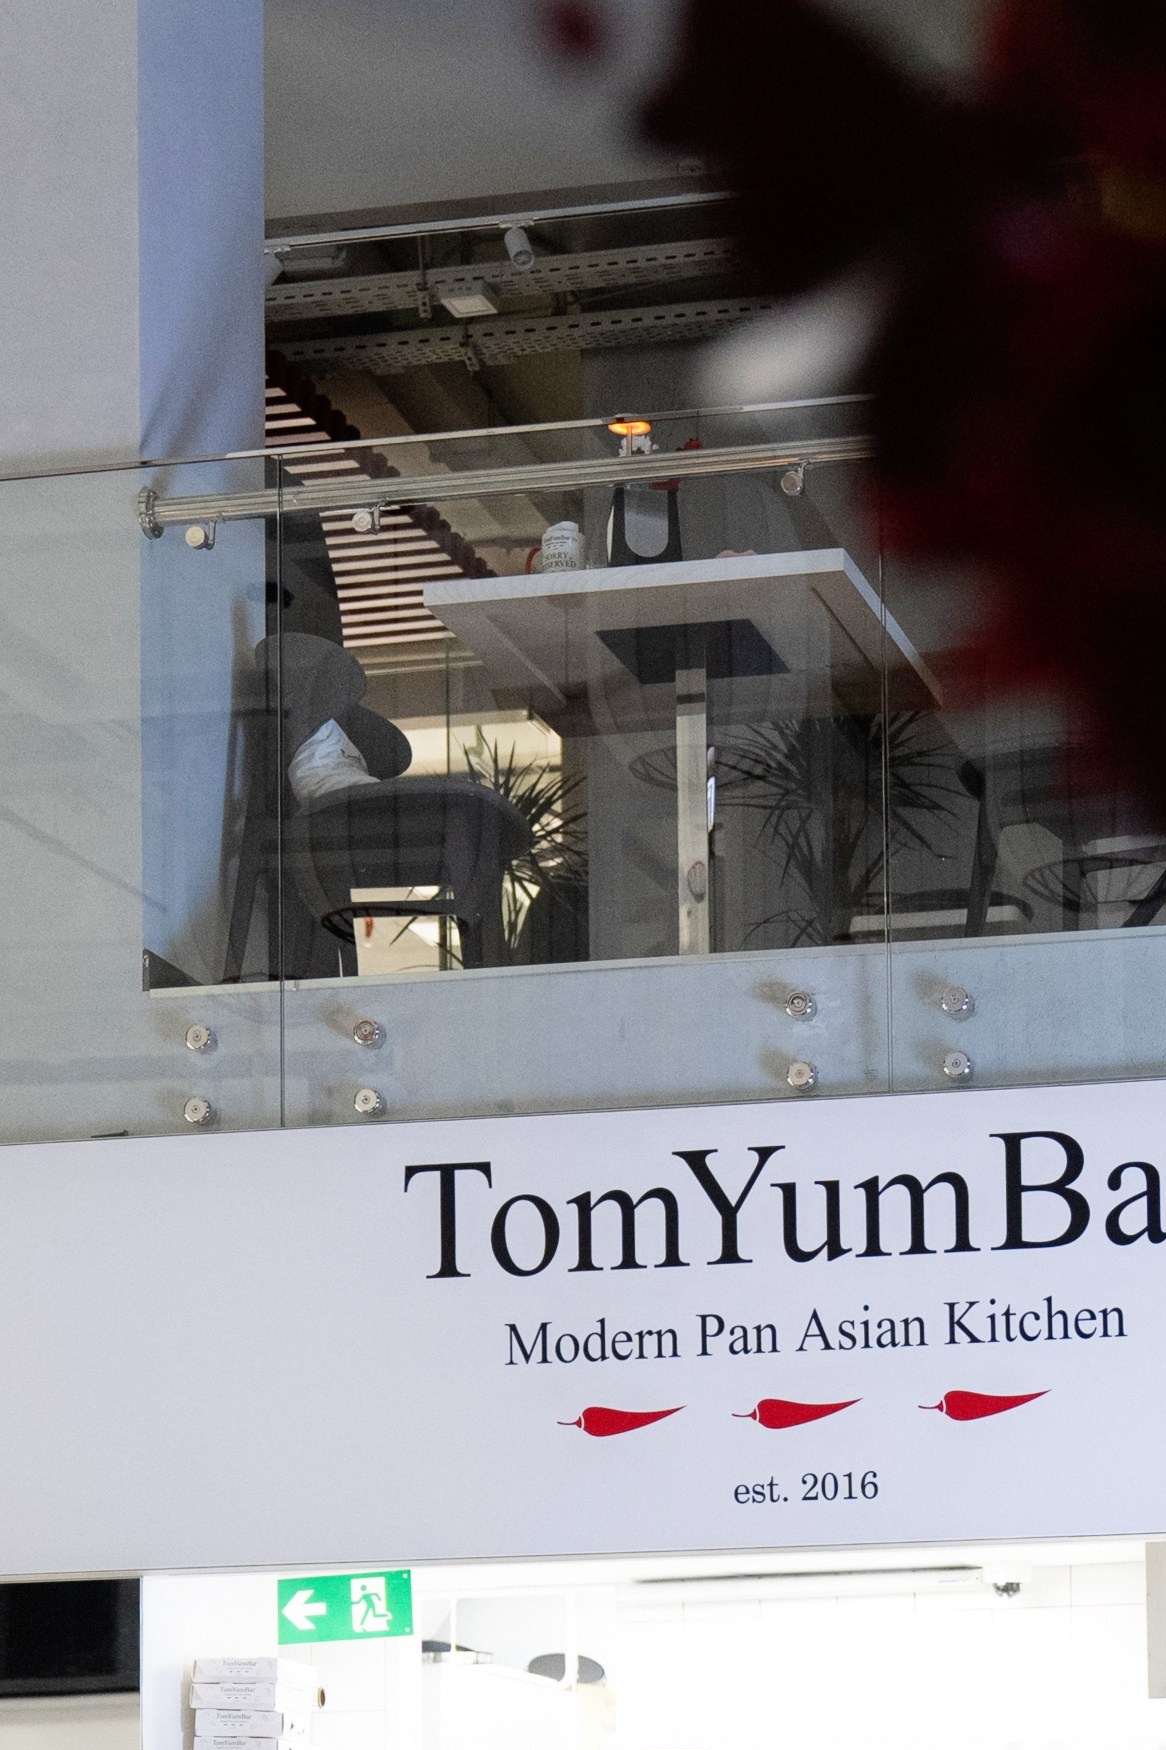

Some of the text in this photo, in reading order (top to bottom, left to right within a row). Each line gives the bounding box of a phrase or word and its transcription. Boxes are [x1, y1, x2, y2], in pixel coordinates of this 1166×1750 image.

[504, 1295, 1129, 1366] Modern Pan Asian Kitchen
[733, 1470, 880, 1505] est. 2016
